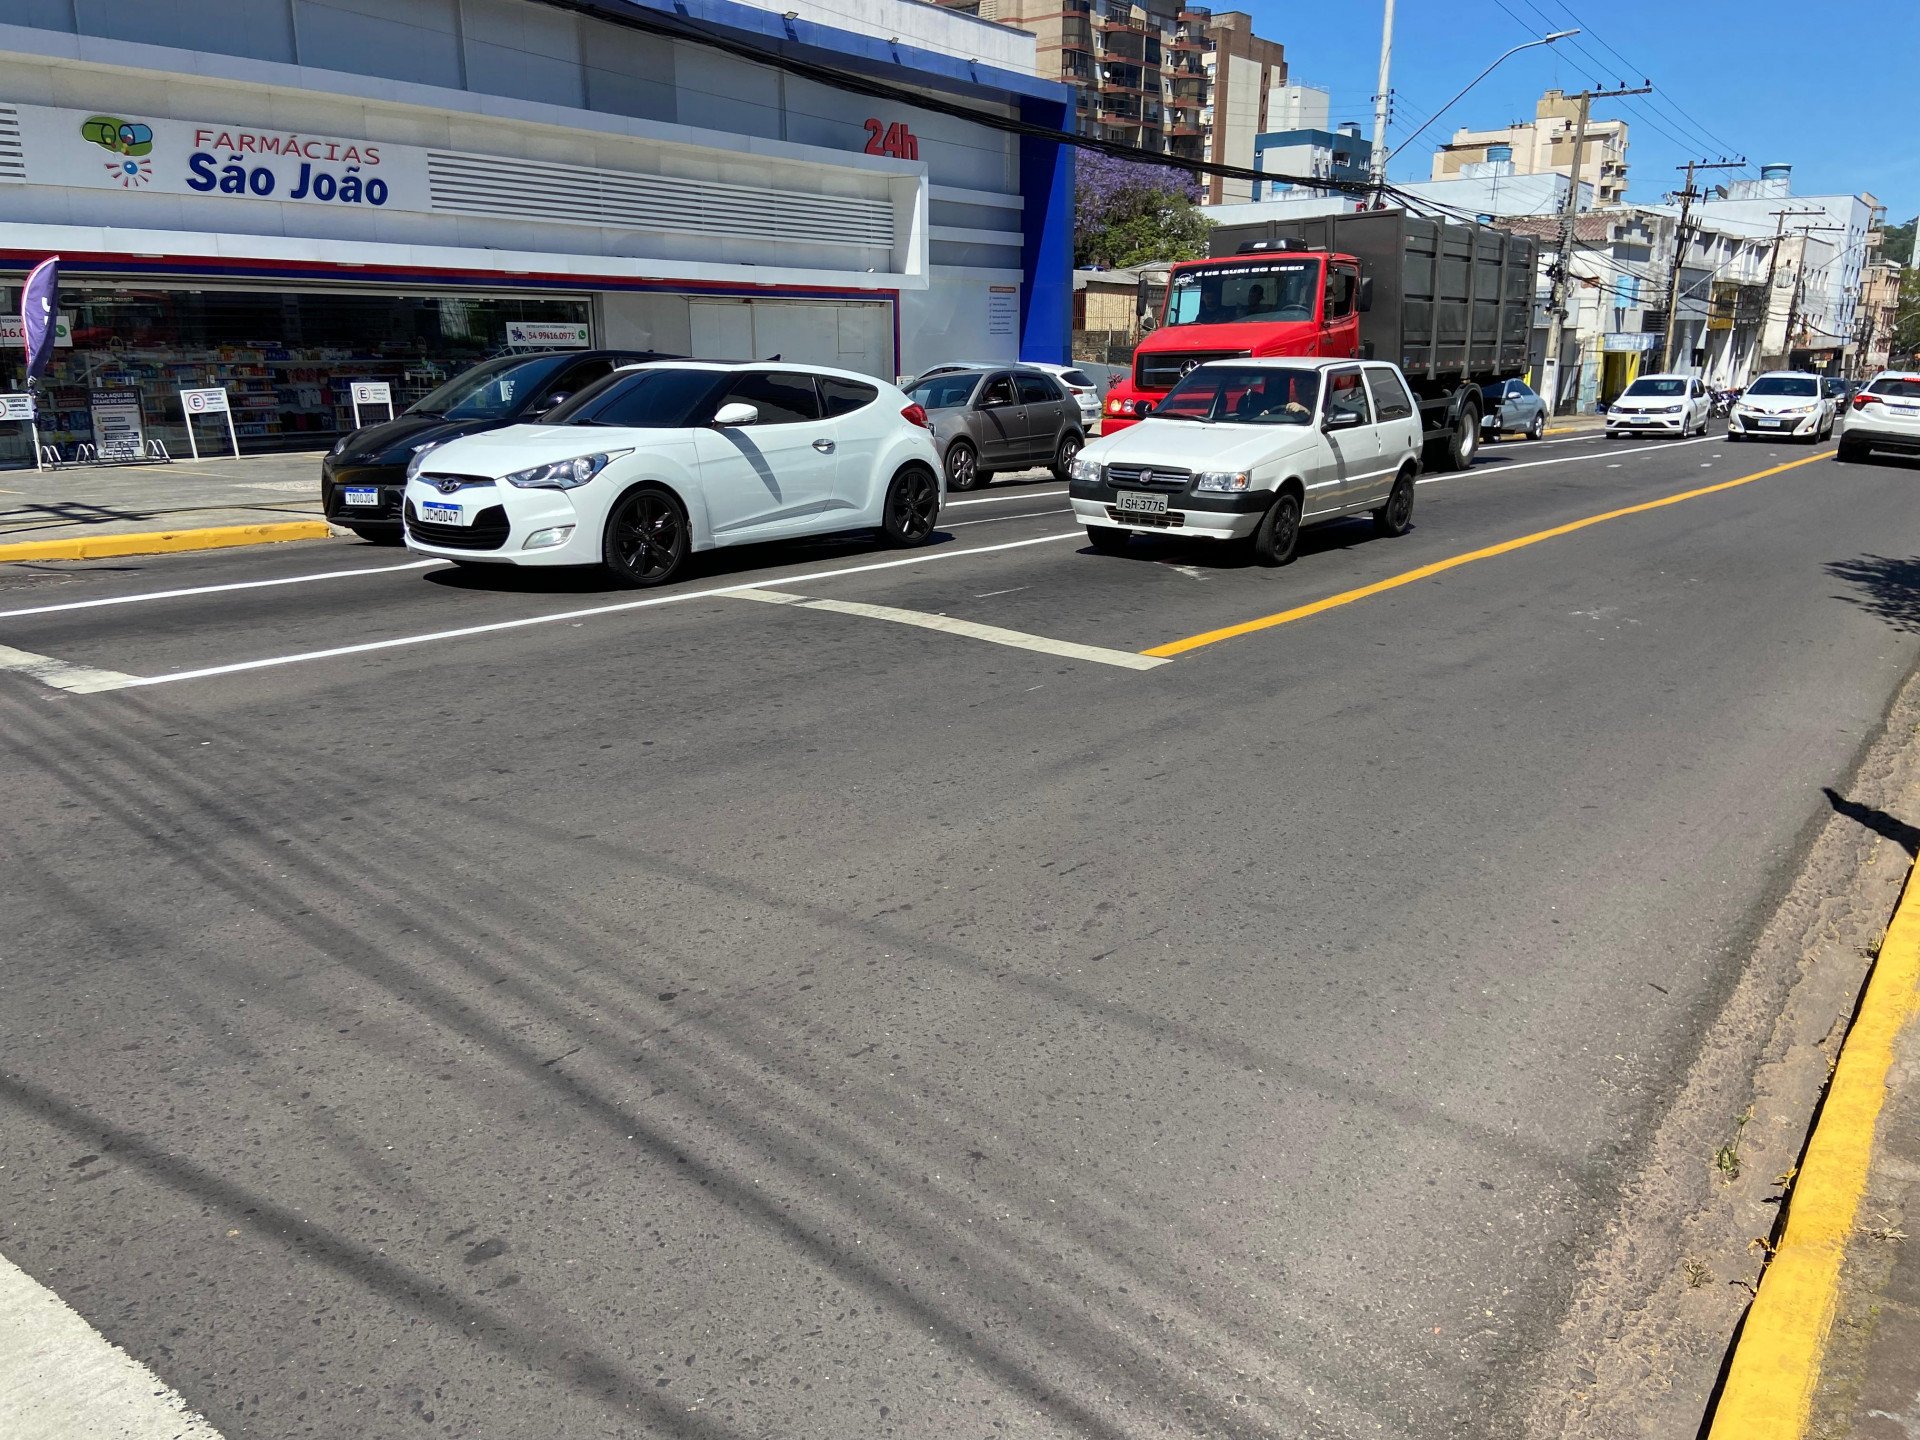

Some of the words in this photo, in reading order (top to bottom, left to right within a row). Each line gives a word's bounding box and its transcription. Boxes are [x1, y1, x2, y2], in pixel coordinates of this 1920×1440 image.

[864, 118, 919, 160] 24h
[194, 129, 381, 165] FARMÁCIAS
[186, 152, 276, 196] São
[290, 162, 389, 206] João
[528, 332, 537, 340] 54
[360, 389, 368, 399] E
[193, 397, 201, 407] E
[1120, 498, 1165, 512] ISH-3776
